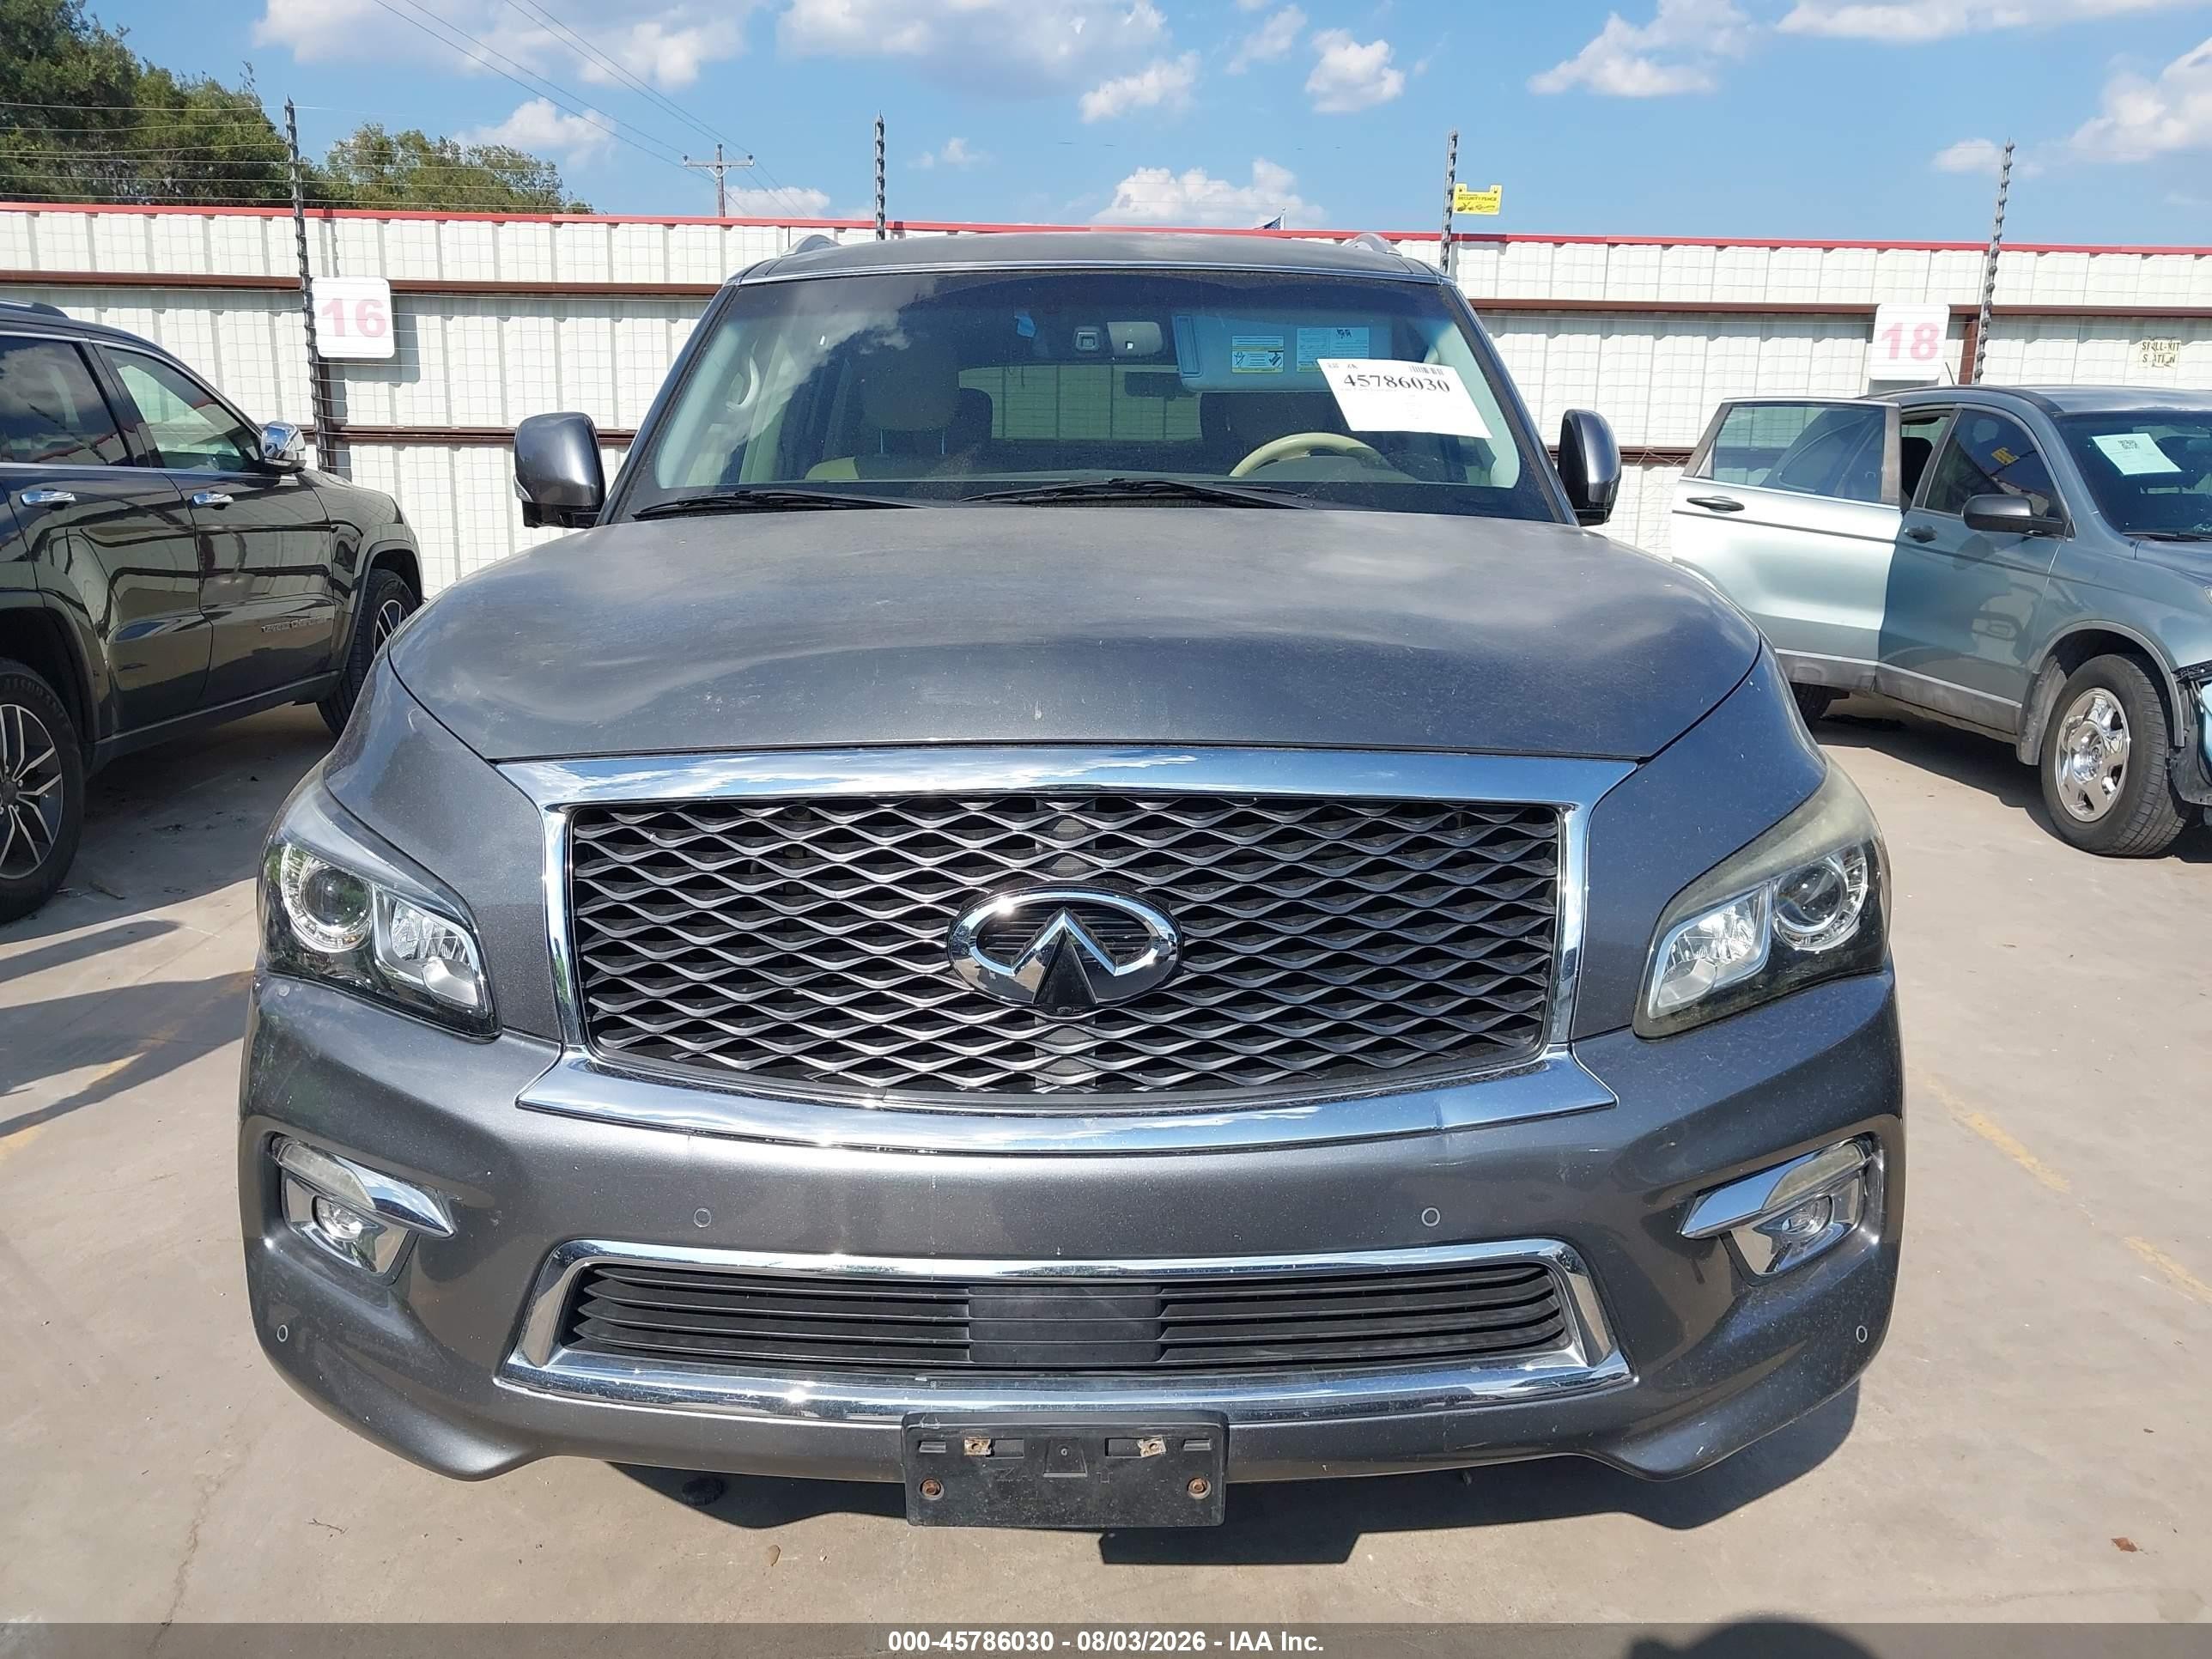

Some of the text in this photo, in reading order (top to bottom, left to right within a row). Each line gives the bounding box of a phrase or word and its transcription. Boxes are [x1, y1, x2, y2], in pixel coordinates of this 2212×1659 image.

[322, 298, 386, 337] 16
[1881, 322, 1940, 361] 18
[1343, 374, 1451, 392] 45786030
